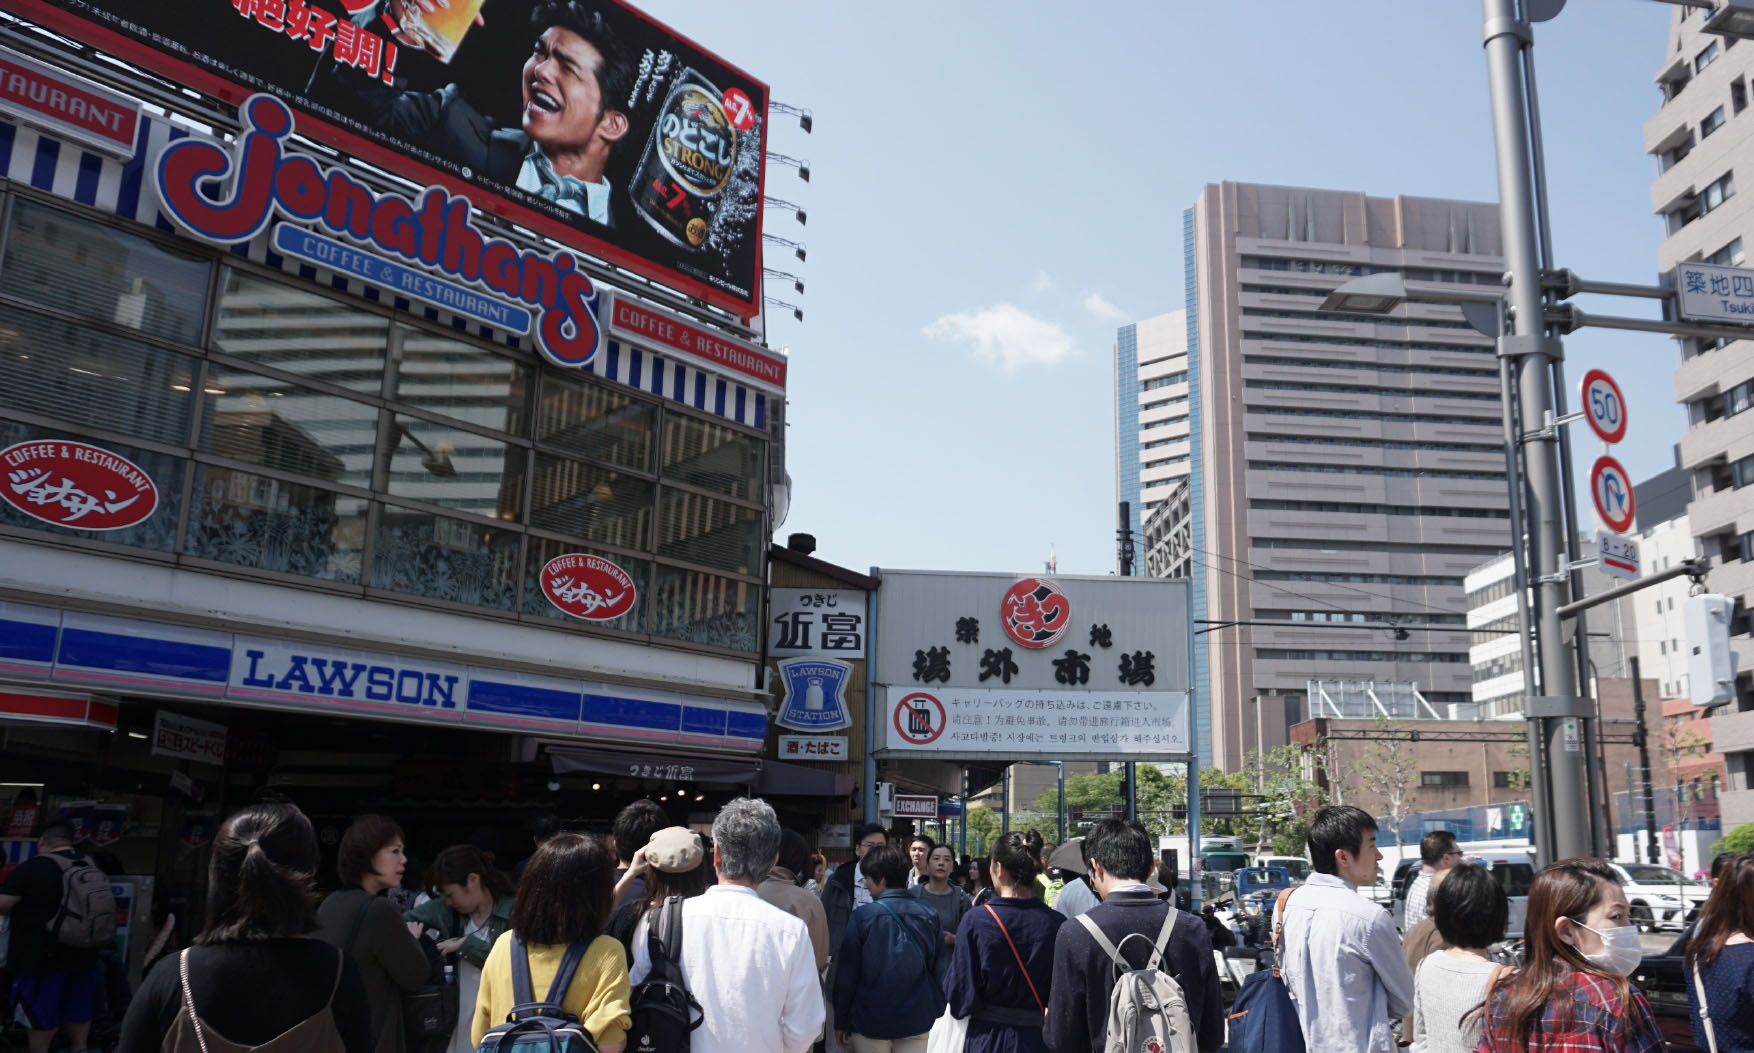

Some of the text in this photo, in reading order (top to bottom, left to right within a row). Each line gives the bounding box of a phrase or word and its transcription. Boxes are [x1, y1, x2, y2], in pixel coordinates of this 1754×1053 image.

[663, 137, 724, 180] STRONG
[303, 236, 512, 325] COFFEE & RESTAURANT
[1685, 269, 1754, 298] 築地四
[619, 306, 782, 380] COFFEE & RESTAURANT
[1591, 387, 1618, 426] 50
[5, 444, 151, 493] COFFEE & RESTAURANT
[8, 467, 141, 522] ジョナサン
[547, 557, 632, 589] COFFEE & RESTAURANT
[550, 575, 627, 615] ジョナサン
[800, 593, 838, 608] つきじ
[774, 611, 862, 651] 近富
[242, 648, 459, 708] LAWSON
[791, 666, 842, 680] LAWSON
[788, 709, 840, 722] STATION
[629, 764, 695, 781] つきじ近富
[896, 799, 936, 813] EXCHANGE
